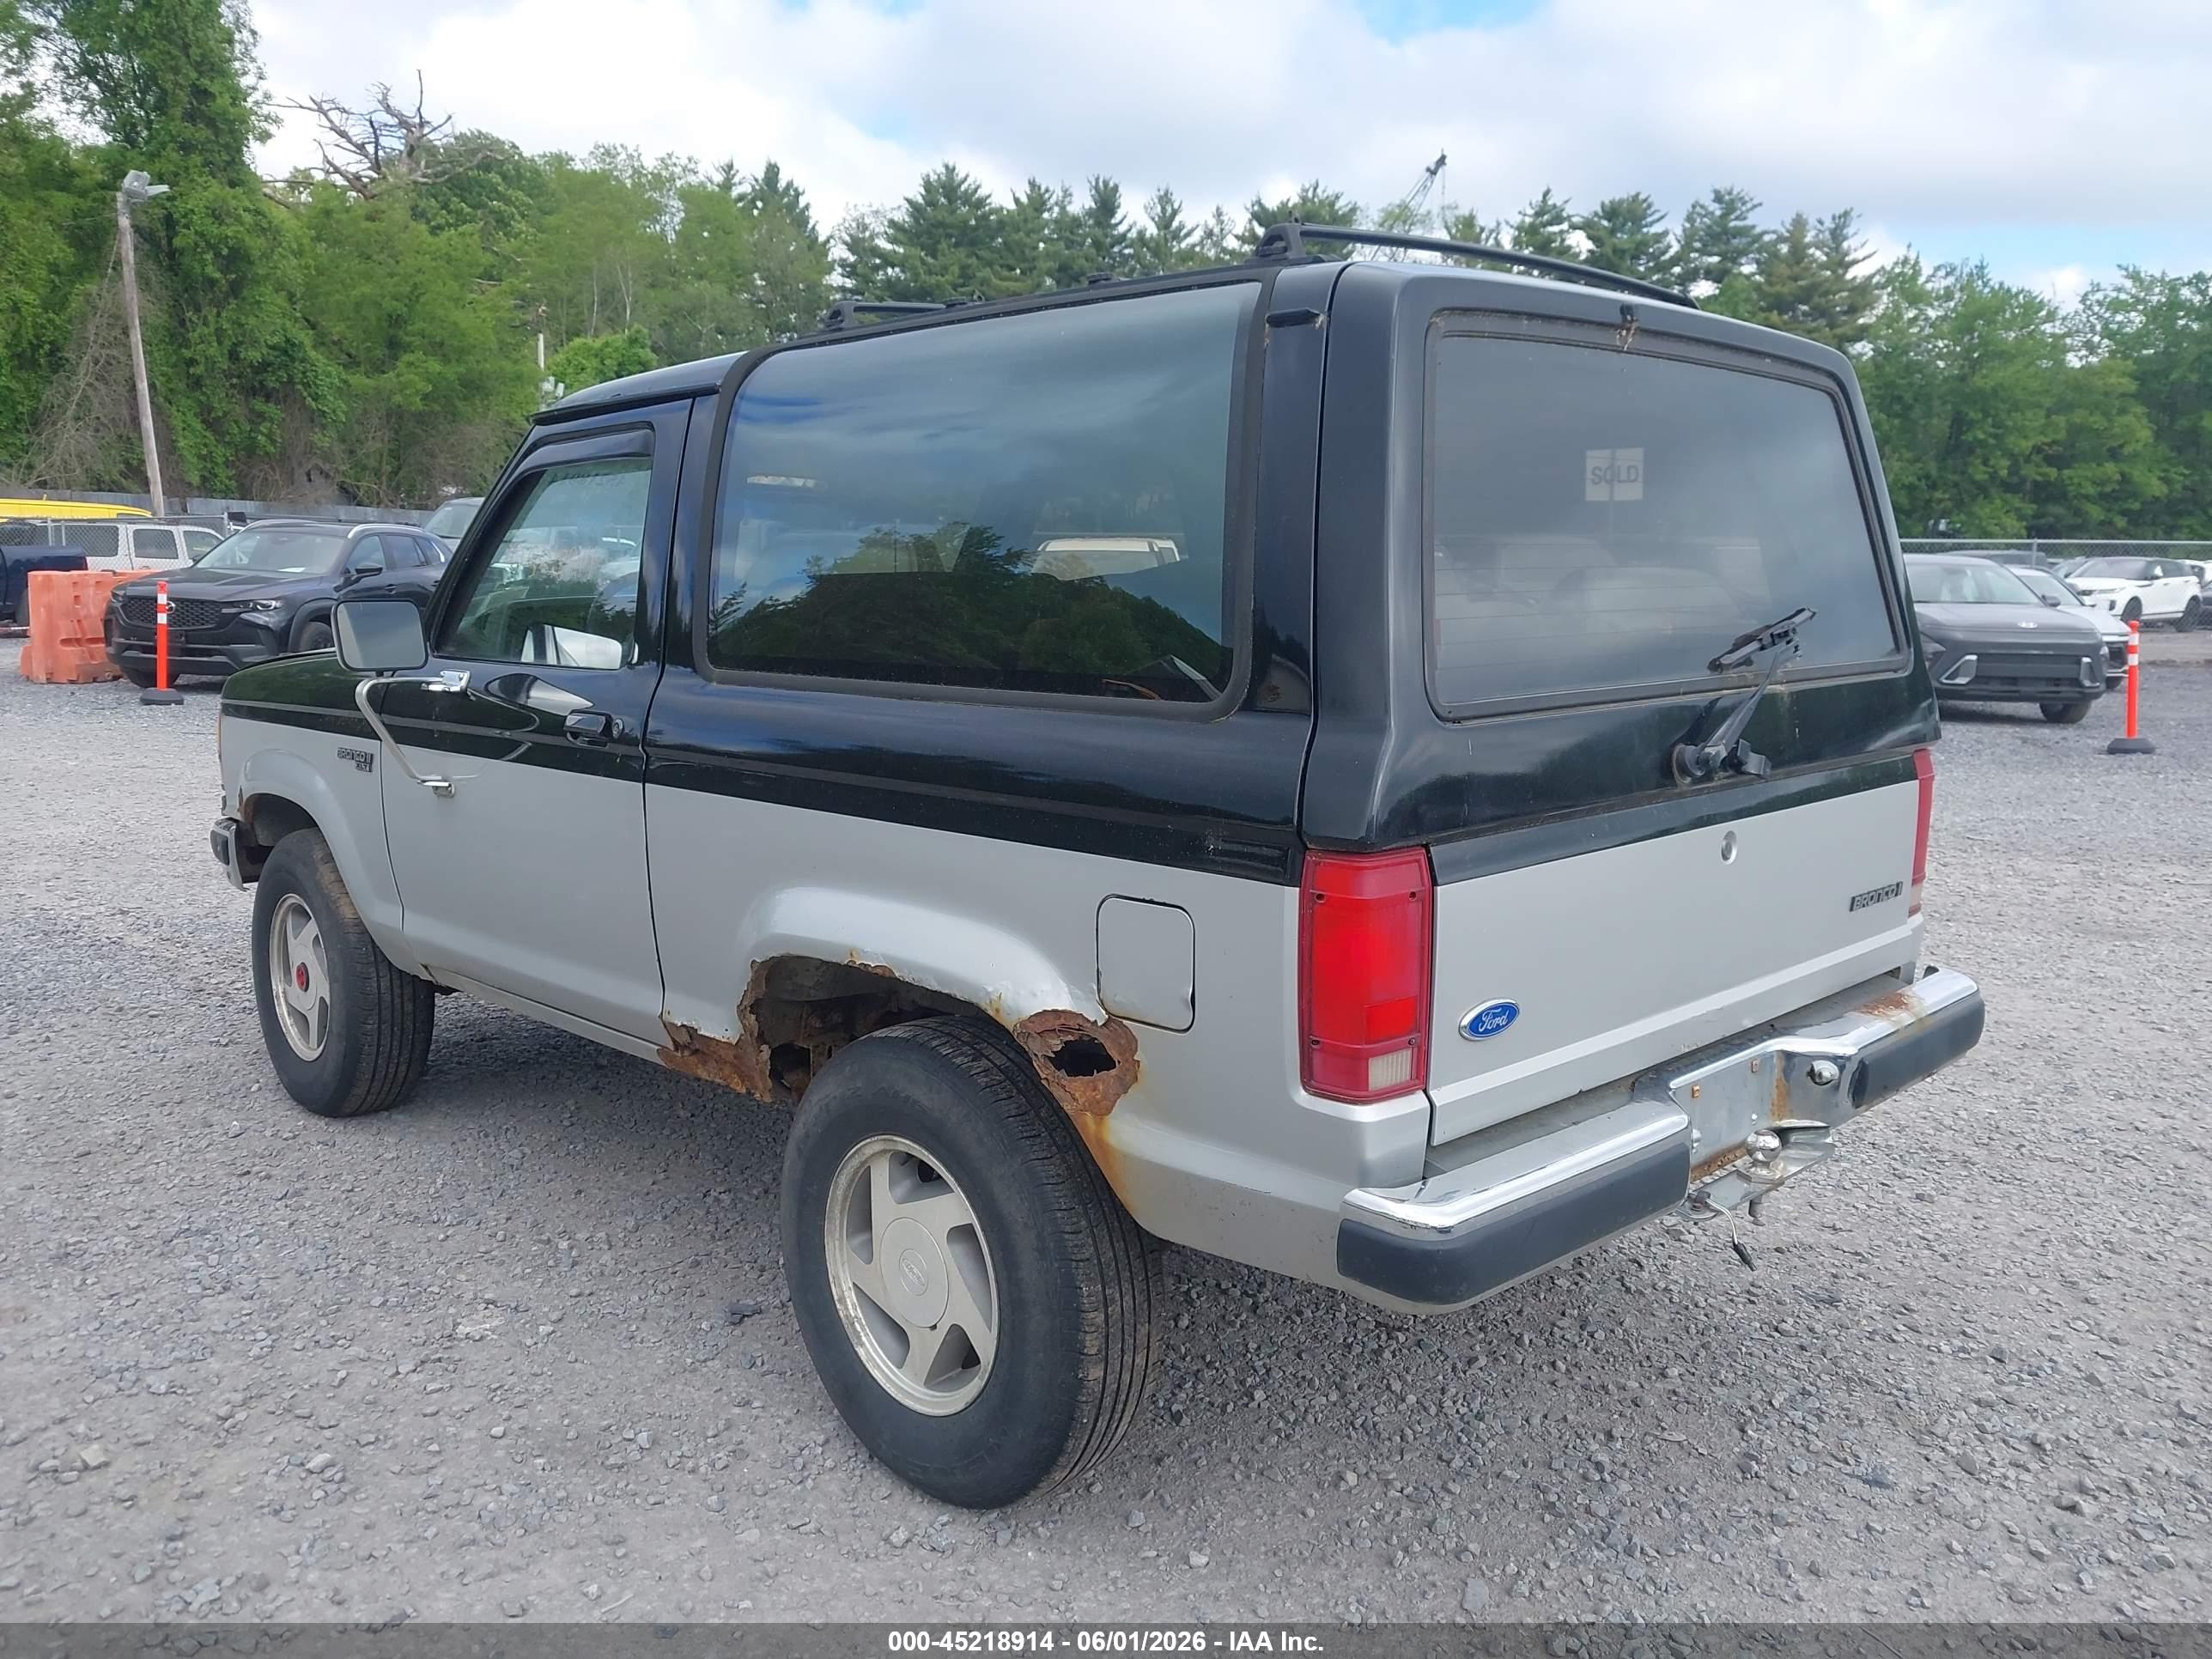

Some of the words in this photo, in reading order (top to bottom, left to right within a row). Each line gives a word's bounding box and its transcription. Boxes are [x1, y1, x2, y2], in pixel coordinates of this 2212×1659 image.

[1590, 465, 1639, 486] SOLD
[337, 747, 367, 763] BRONCO
[356, 763, 372, 773] XLT
[1852, 884, 1897, 911] BRONCO
[1478, 1007, 1510, 1032] Ford
